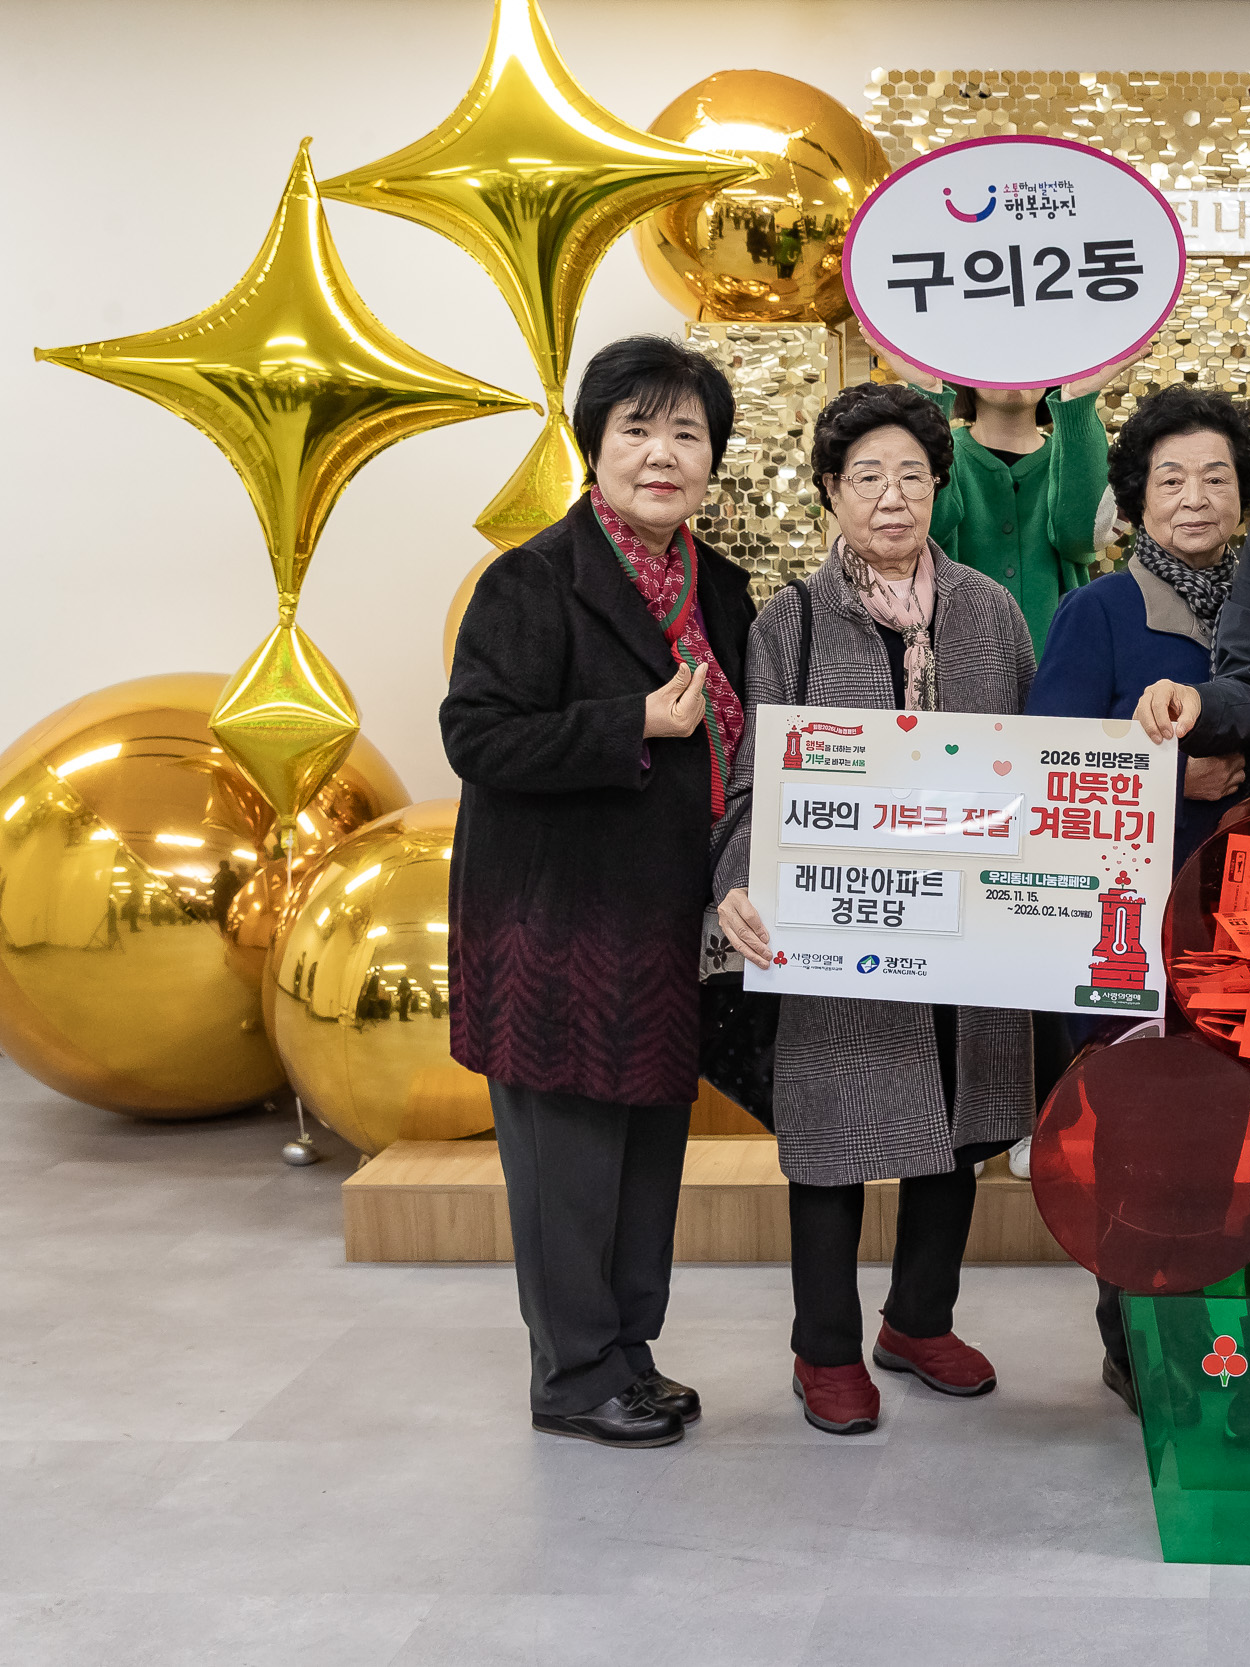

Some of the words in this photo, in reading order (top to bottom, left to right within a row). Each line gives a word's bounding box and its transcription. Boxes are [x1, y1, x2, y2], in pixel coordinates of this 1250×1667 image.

[1003, 182, 1037, 197] 소통하며
[1038, 180, 1075, 196] 발전하는
[1004, 195, 1076, 220] 행복광진
[886, 239, 1144, 313] 구의2동
[805, 740, 831, 752] 행복을
[832, 744, 851, 753] 더하는
[853, 745, 866, 754] 기부
[805, 753, 831, 766] 기부로
[832, 758, 851, 767] 바꾸는
[852, 759, 866, 767] 서울
[1040, 750, 1081, 766] 2026
[1084, 751, 1150, 770] 희망온돌
[1047, 771, 1143, 806] 따뜻한
[785, 799, 860, 830] 사랑의
[872, 804, 947, 835] 기부금
[961, 808, 1013, 838] 전달
[1029, 807, 1155, 843] 겨울나기
[795, 865, 943, 897] 래미안아파트
[988, 871, 1033, 885] 우리동네
[1035, 874, 1091, 888] 나눔캠페인
[831, 897, 905, 927] 경로당
[882, 968, 928, 977] GWANGJIN-GU
[884, 956, 928, 970] 광진구
